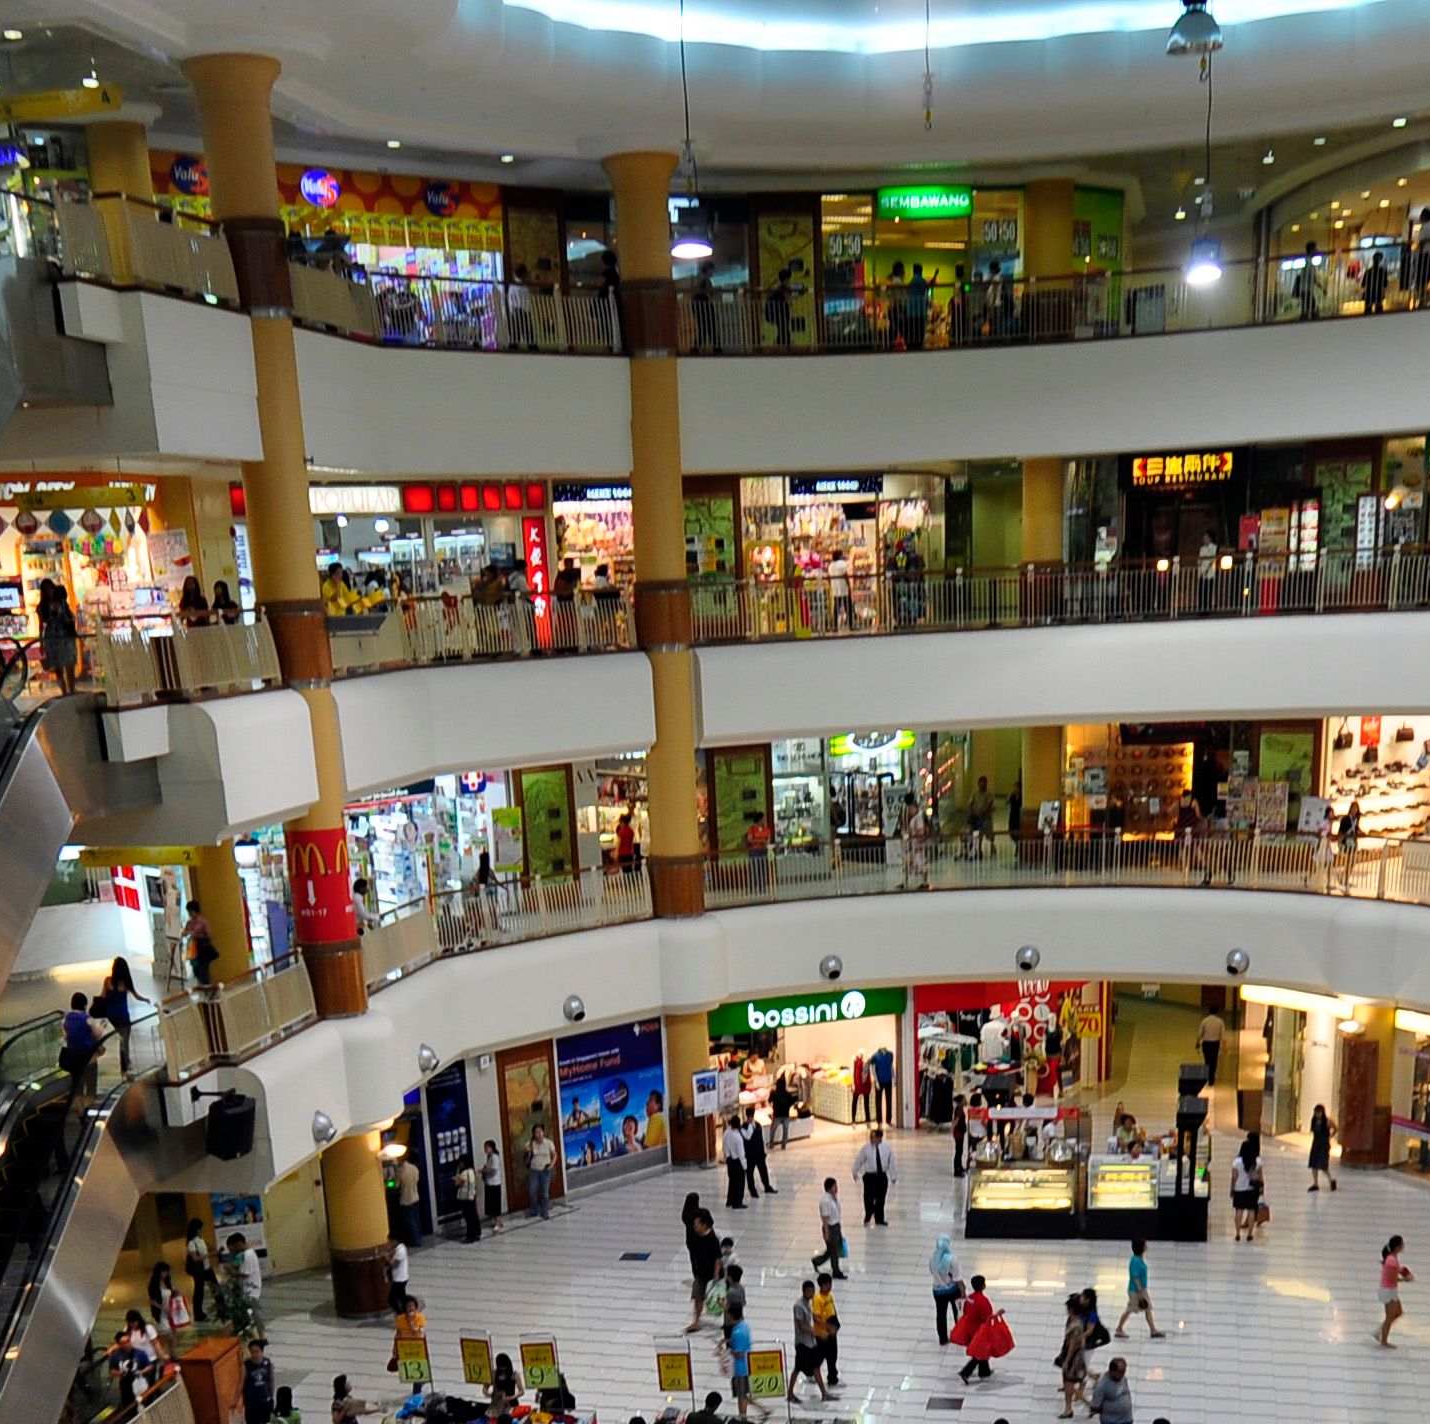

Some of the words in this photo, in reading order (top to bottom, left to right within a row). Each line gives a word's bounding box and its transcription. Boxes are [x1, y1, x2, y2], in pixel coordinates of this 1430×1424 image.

[314, 489, 398, 511] POPULAR
[748, 1001, 838, 1030] bossini
[1079, 1016, 1100, 1034] 70
[403, 1361, 424, 1380] 13
[754, 1376, 779, 1393] 20
